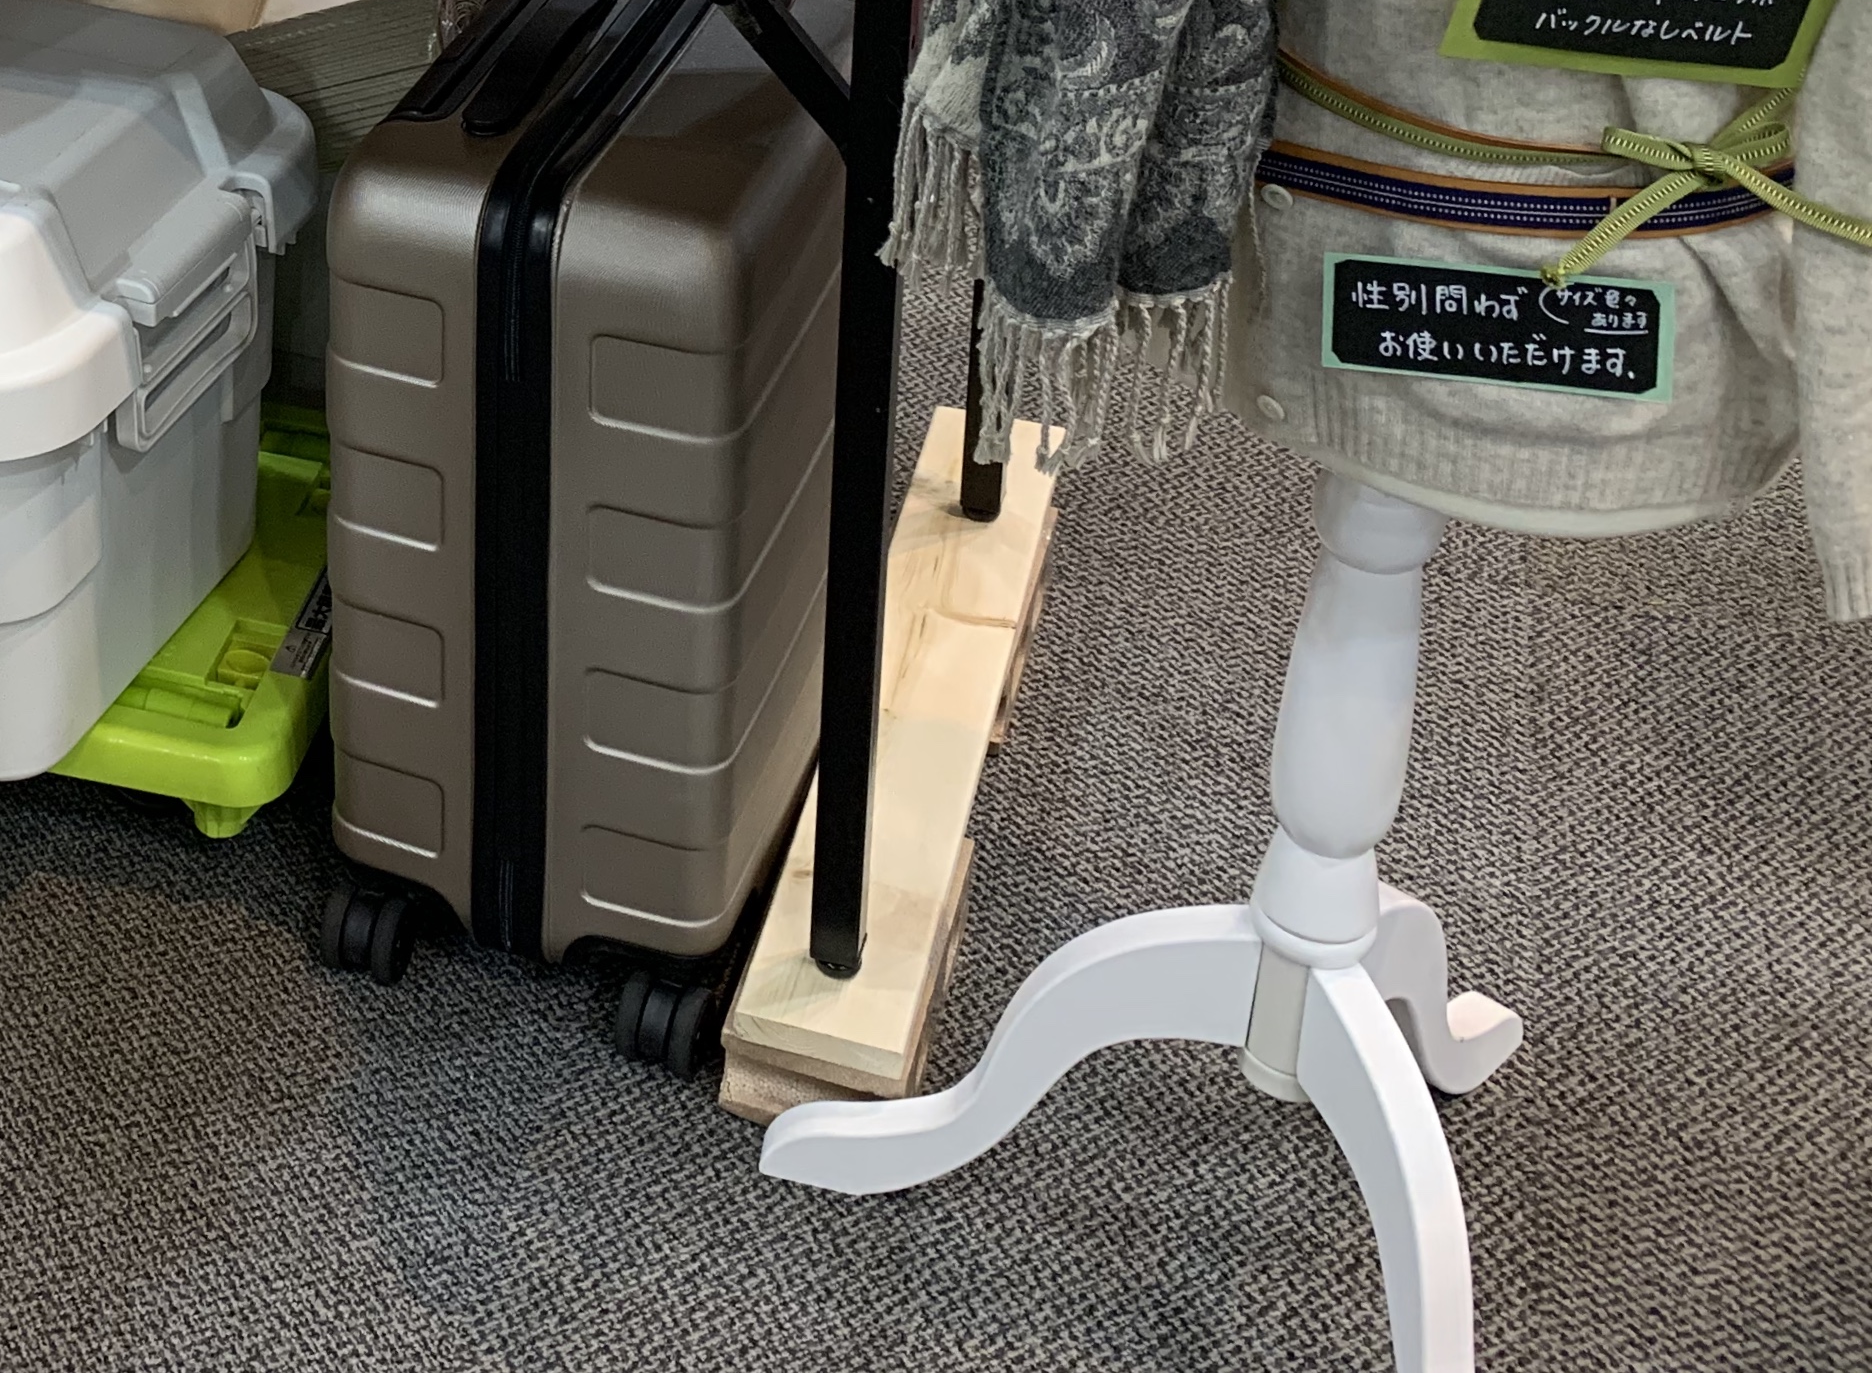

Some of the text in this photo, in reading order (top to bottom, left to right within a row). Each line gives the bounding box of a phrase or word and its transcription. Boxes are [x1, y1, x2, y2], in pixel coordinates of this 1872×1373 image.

[1535, 8, 1752, 47] バックルなしベルト
[1352, 280, 1528, 321] 性別問わず
[1591, 311, 1648, 330] あります
